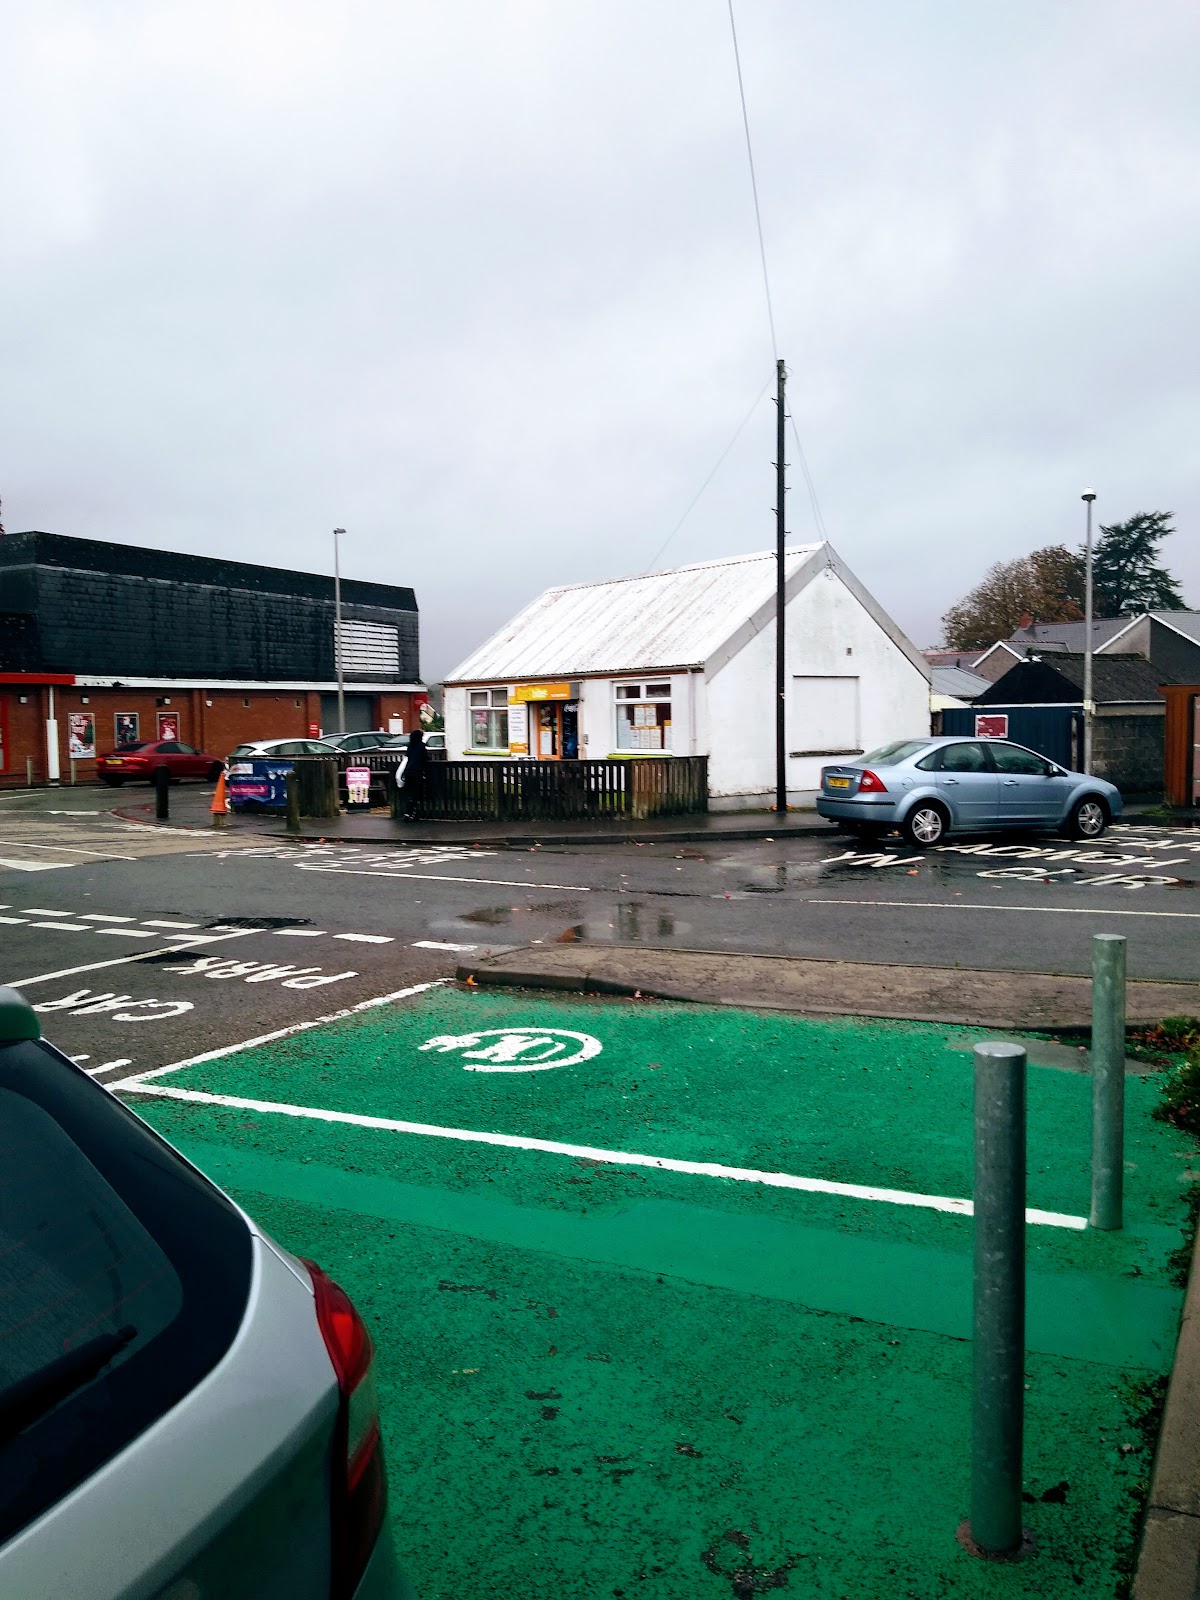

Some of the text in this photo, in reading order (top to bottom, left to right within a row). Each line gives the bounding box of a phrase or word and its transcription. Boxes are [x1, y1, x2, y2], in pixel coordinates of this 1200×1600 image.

[820, 851, 1179, 889] YN GLIR
[886, 843, 1190, 868] ADWCH
[162, 956, 359, 989] PARK
[32, 989, 195, 1022] CAR
